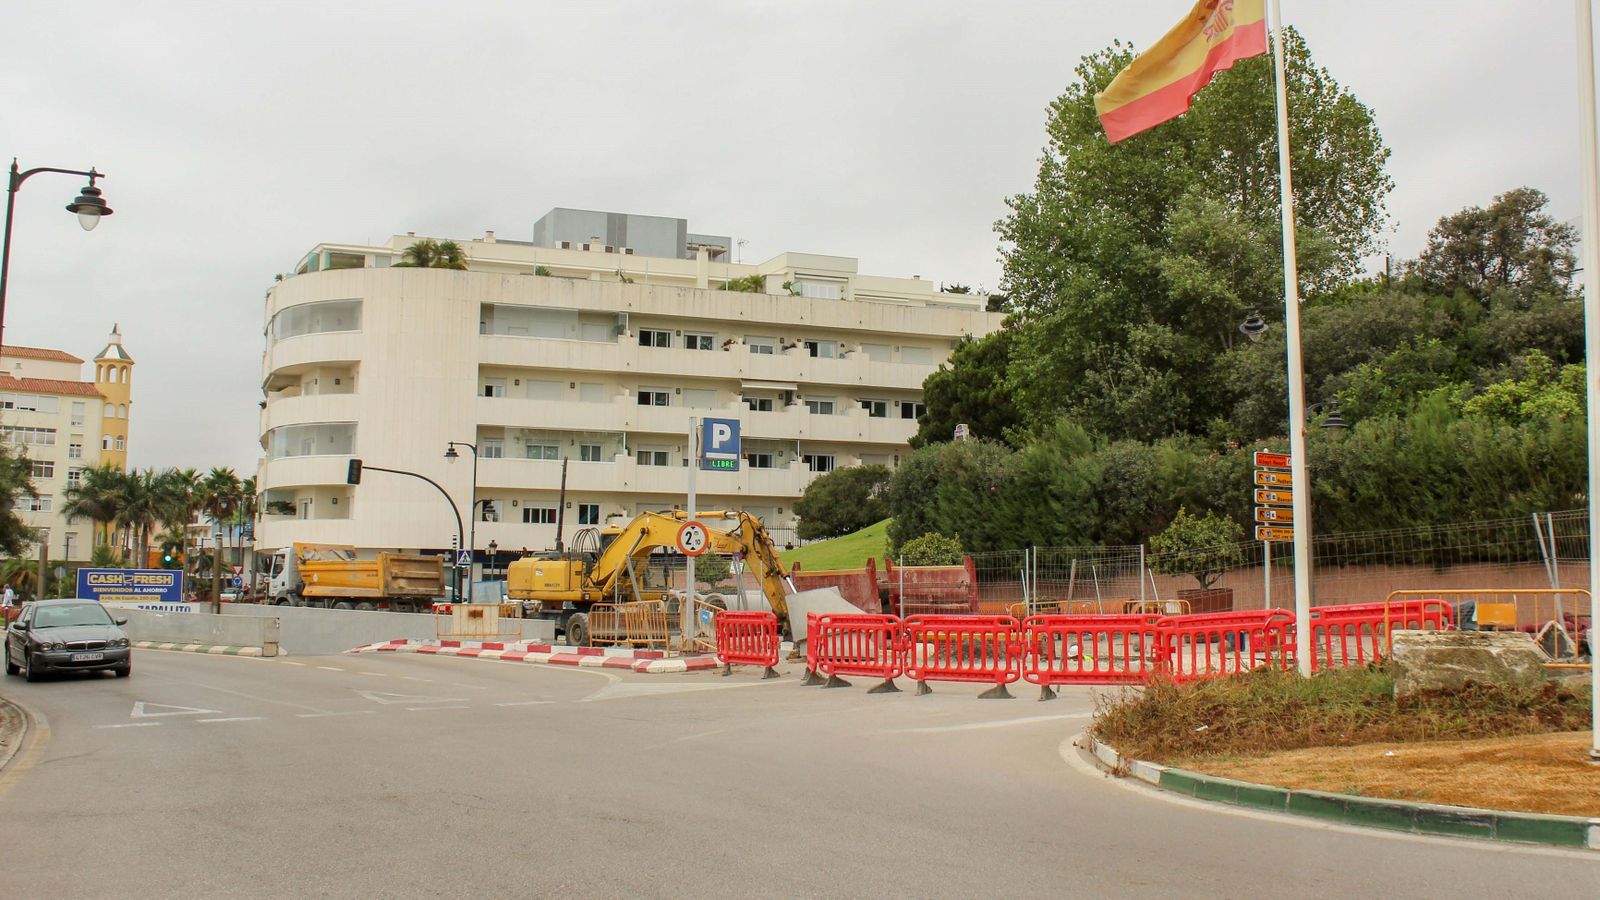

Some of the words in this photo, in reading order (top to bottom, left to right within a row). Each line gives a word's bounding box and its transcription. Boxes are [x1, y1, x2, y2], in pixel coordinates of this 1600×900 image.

[712, 423, 731, 449] P
[712, 460, 735, 468] LIBRE
[685, 531, 693, 545] 2
[90, 574, 122, 584] CASH
[134, 575, 172, 585] FRESH
